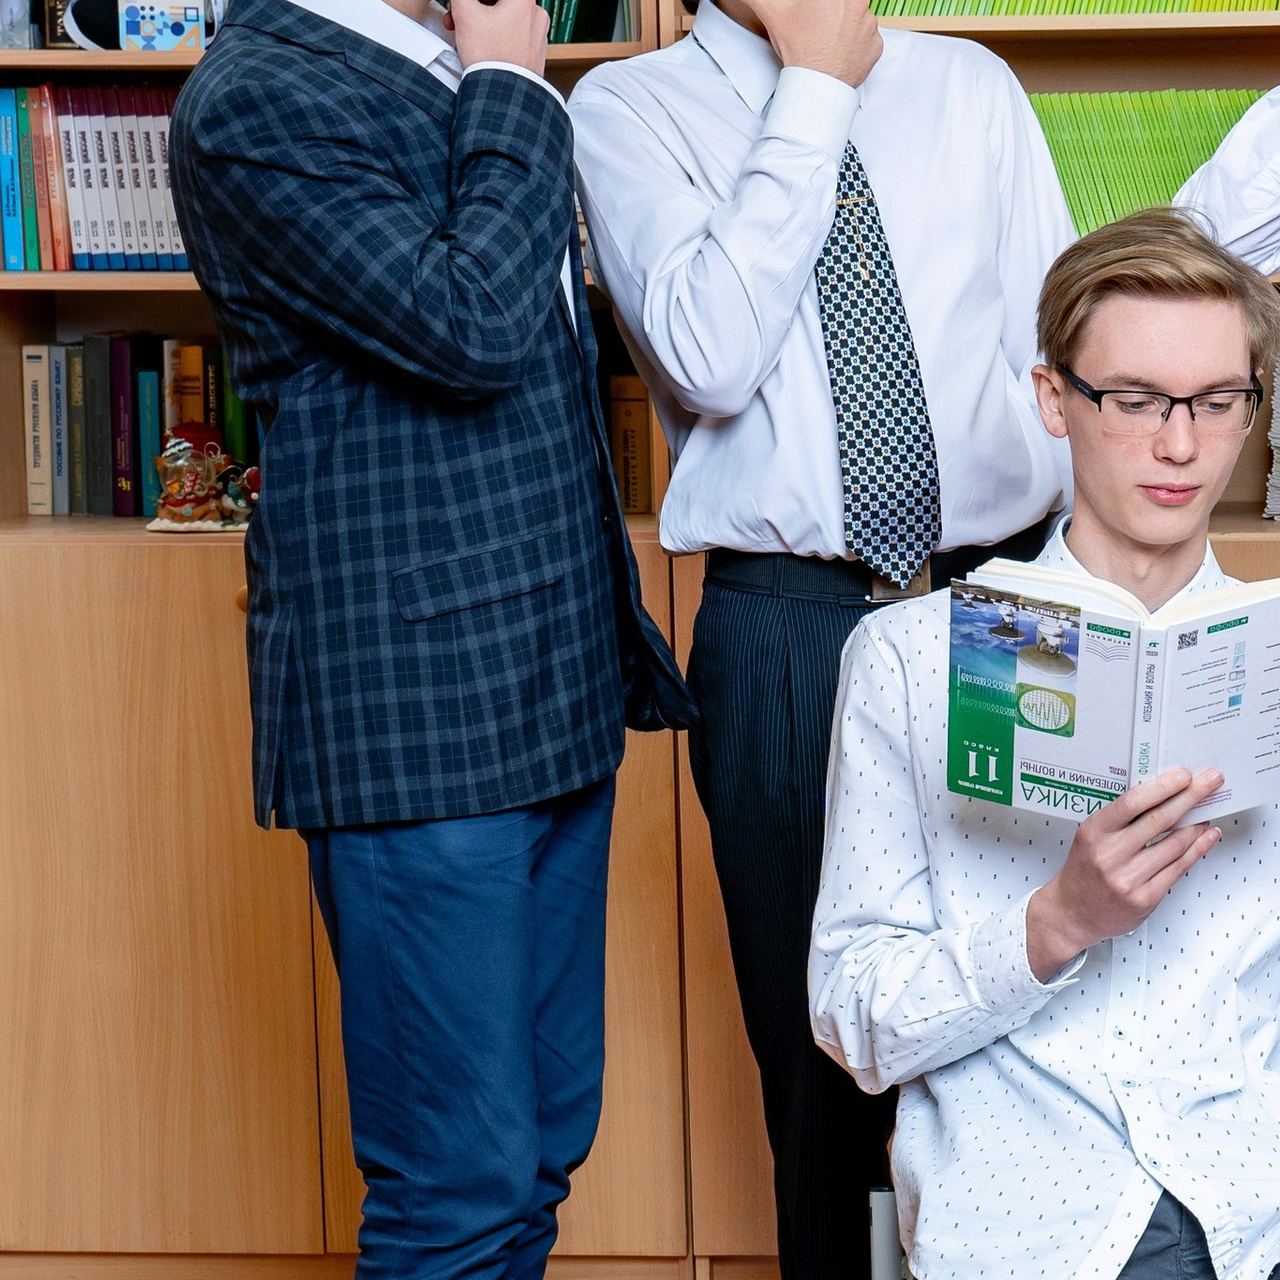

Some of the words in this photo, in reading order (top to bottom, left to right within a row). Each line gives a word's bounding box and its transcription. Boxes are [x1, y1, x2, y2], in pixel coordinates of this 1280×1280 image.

[24, 162, 34, 208] РУССКИЙ
[47, 161, 57, 199] РУССКИЙ
[73, 220, 81, 228] 10
[107, 220, 115, 228] 10
[56, 428, 61, 439] ПО
[1145, 664, 1155, 683] ВОЛНЫ
[1143, 691, 1154, 723] КОЛЕБАНИЯ
[963, 740, 999, 752] класс
[968, 751, 999, 782] 11
[1139, 742, 1151, 775] ФИЗИКА
[1020, 761, 1055, 777] ВОЛНЫ
[1059, 770, 1066, 779] И
[1069, 772, 1127, 792] КОЛЕБАНИЯ
[1020, 782, 1101, 815] ИЗИКА
